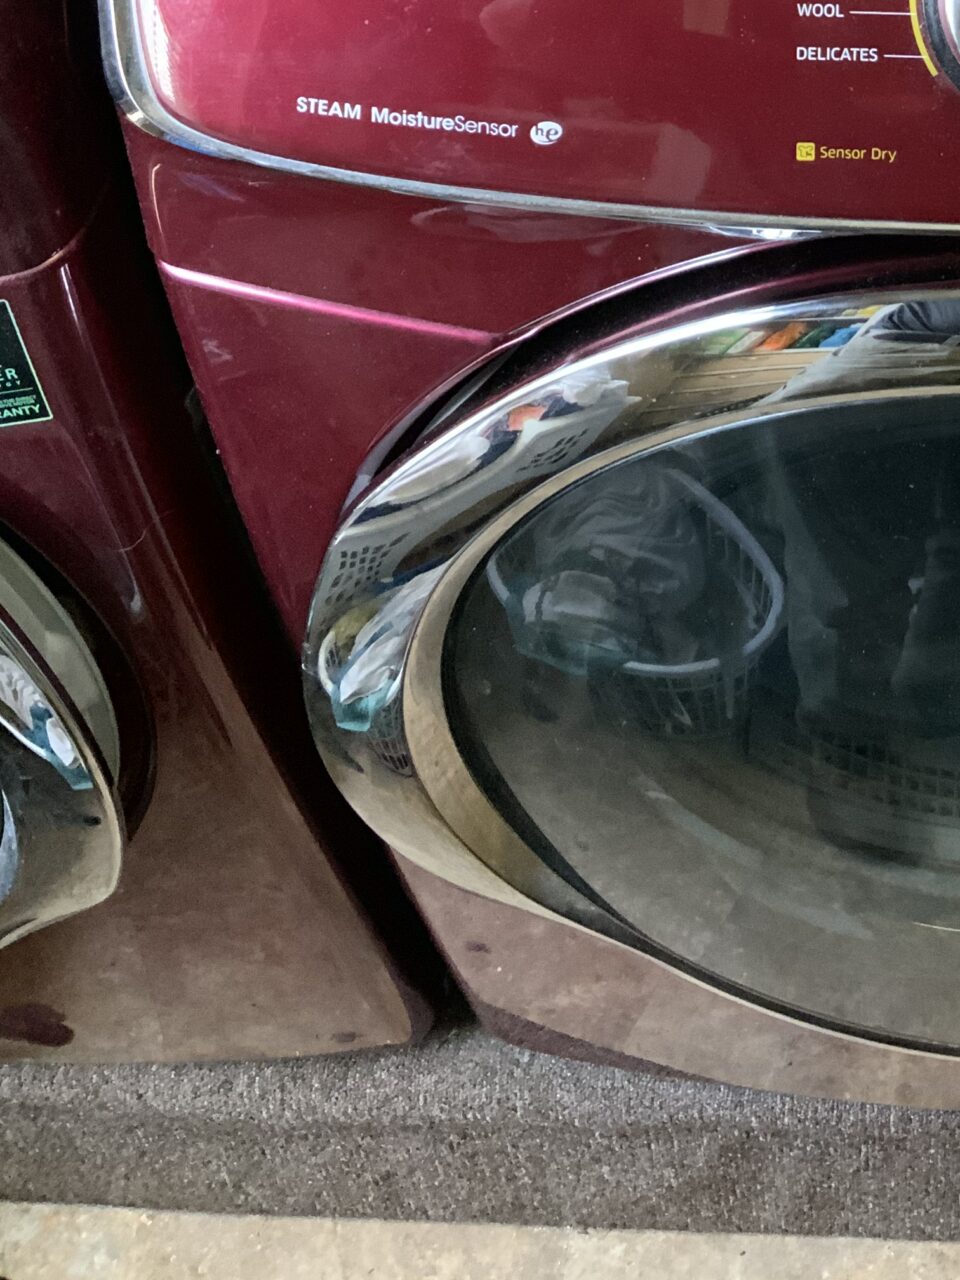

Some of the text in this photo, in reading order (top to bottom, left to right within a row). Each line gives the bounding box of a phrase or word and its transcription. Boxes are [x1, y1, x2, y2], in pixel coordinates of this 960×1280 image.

[797, 3, 844, 17] WOOL
[796, 47, 878, 62] DELICATES
[296, 96, 519, 139] STEAM MoistureSensor
[820, 145, 897, 163] Sensor Dry
